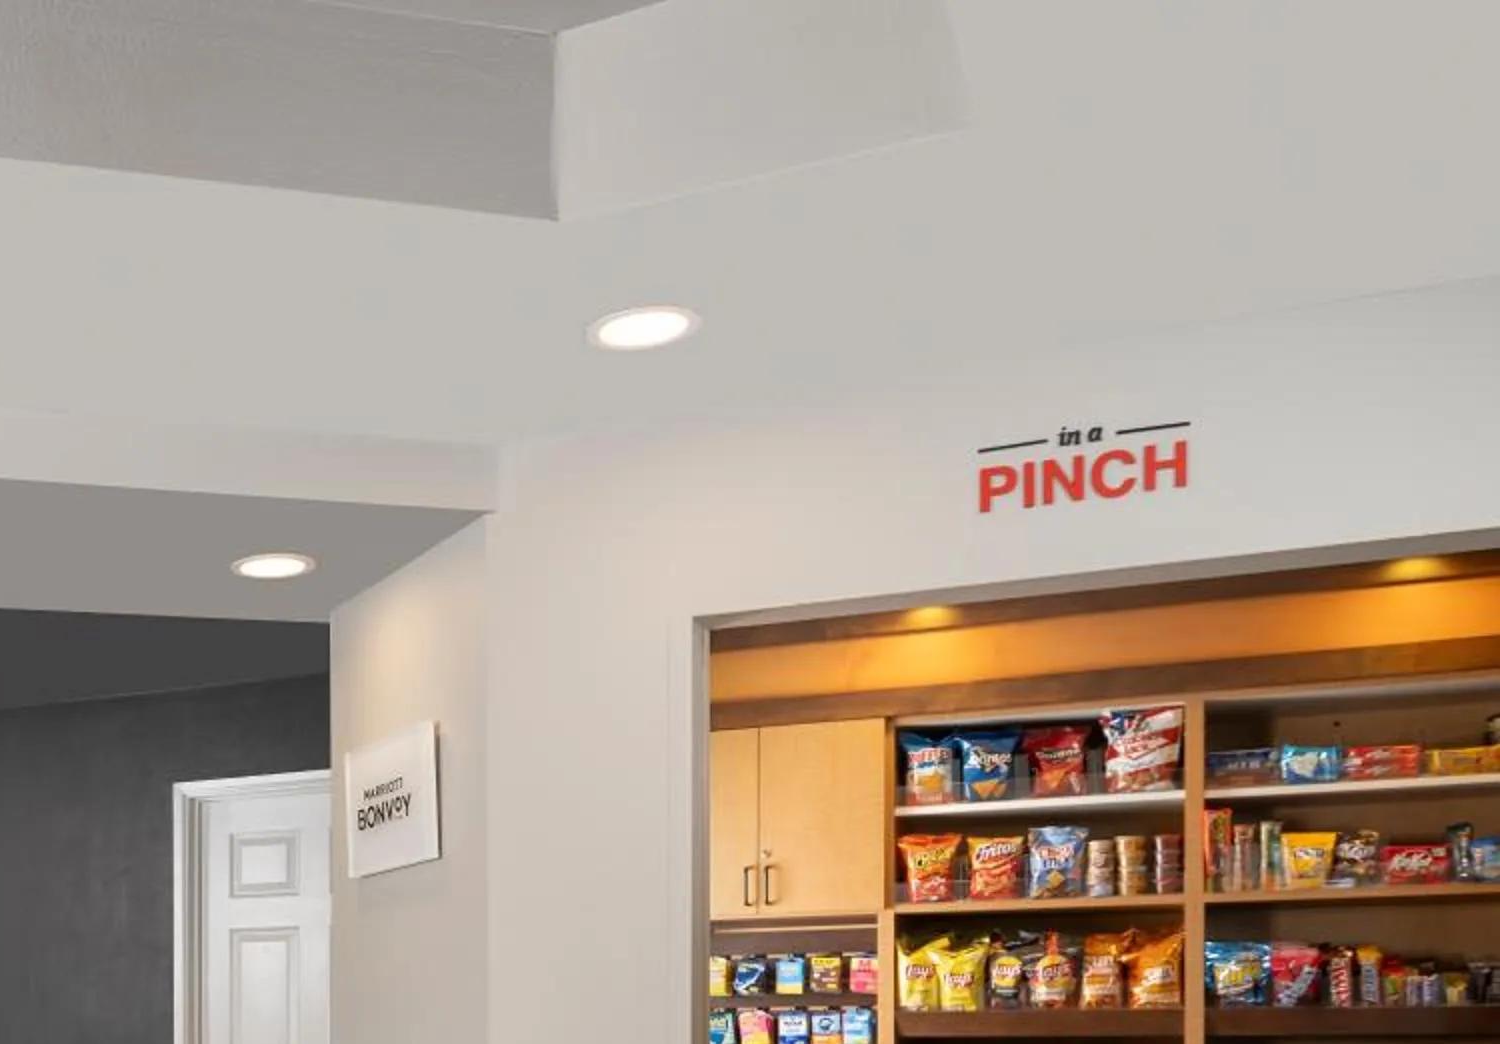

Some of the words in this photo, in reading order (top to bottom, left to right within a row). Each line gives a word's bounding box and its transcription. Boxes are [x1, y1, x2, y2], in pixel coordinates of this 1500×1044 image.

[1057, 426, 1082, 446] in
[1087, 426, 1103, 442] a
[979, 440, 1187, 513] PINCH
[363, 777, 404, 801] MARRIOTT
[357, 793, 412, 831] BONVOY
